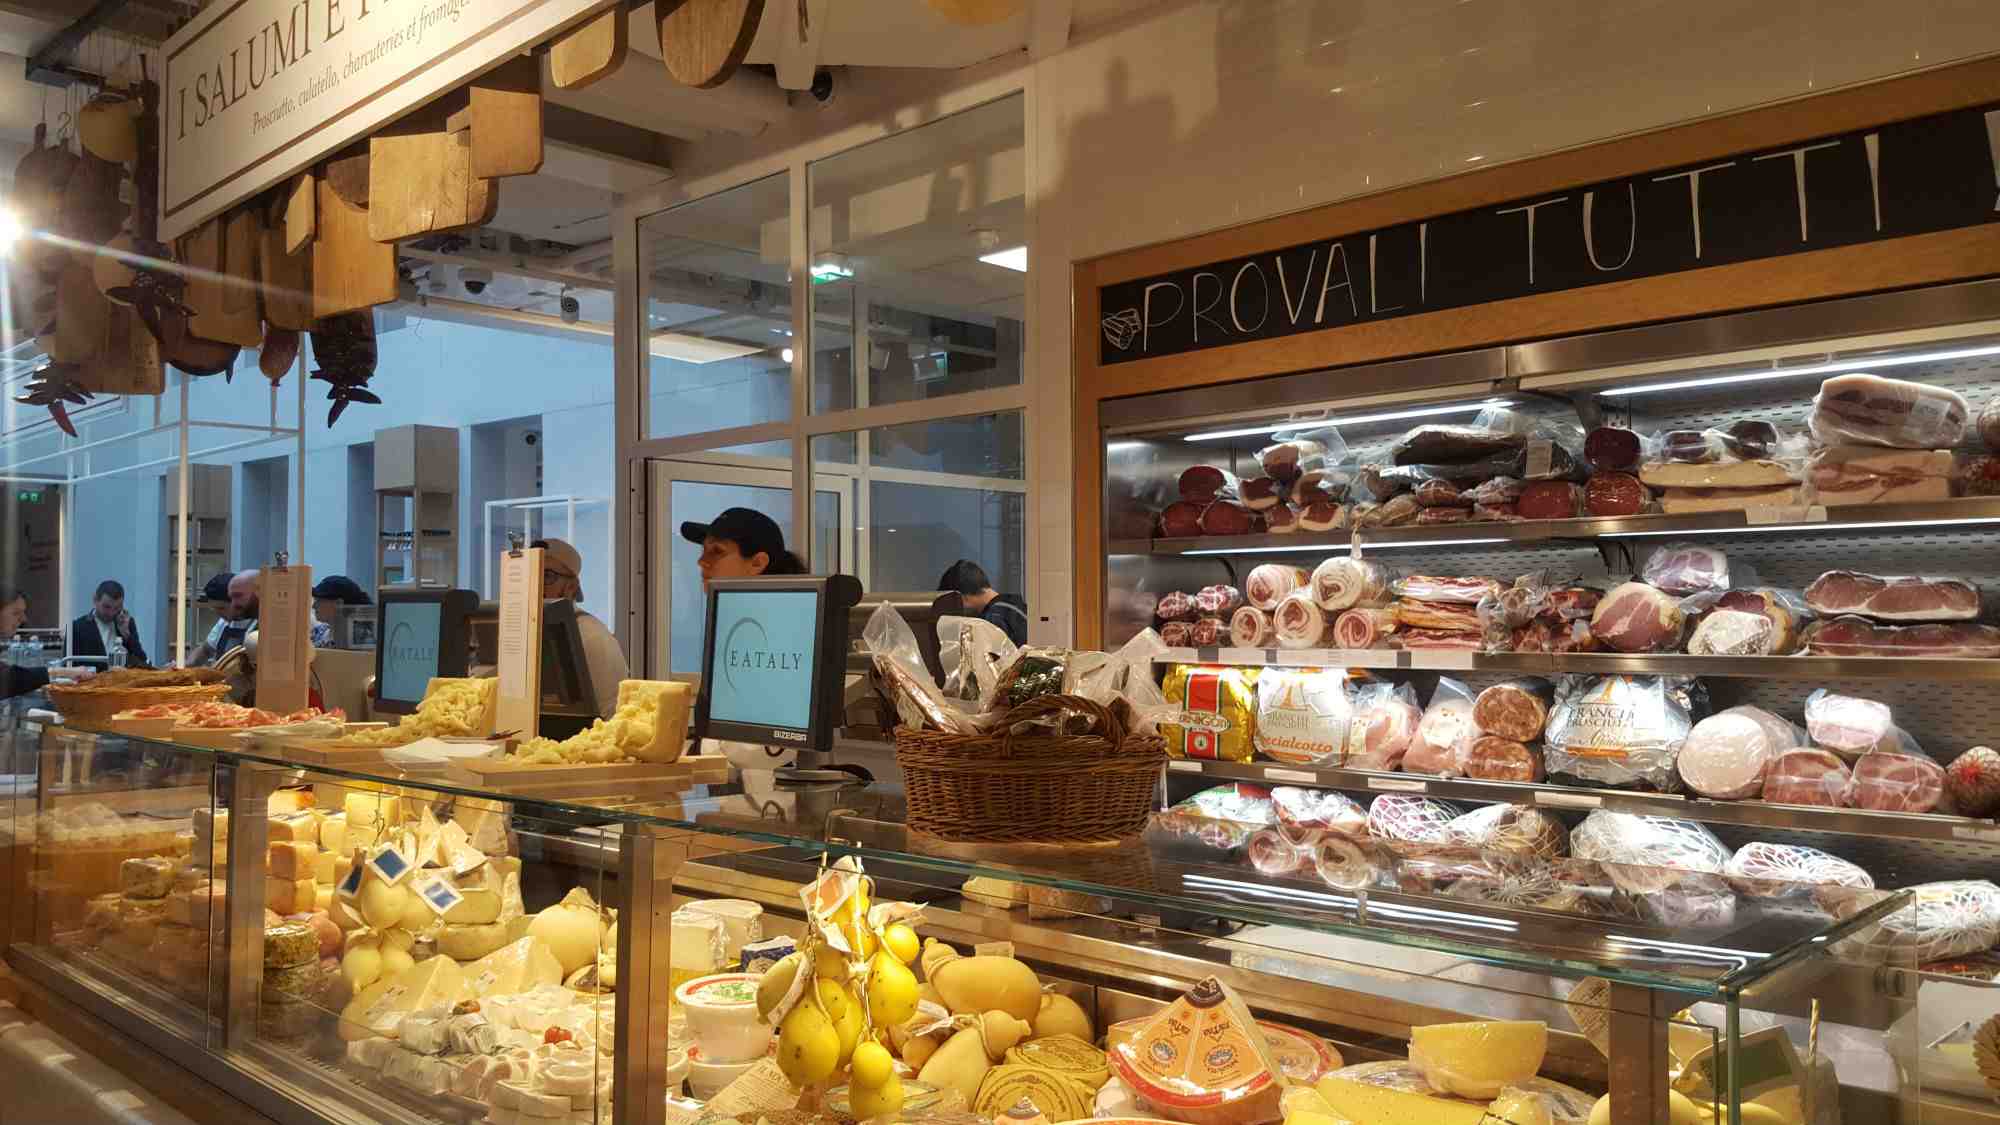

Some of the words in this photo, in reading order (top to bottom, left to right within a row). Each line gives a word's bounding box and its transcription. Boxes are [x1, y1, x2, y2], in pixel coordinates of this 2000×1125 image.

[178, 87, 187, 140] I
[194, 0, 312, 128] SALUMI
[299, 64, 340, 107] culatello,
[343, 27, 405, 79] charcuteries
[406, 14, 417, 41] et
[1143, 223, 1428, 353] PROVALI
[1496, 133, 1884, 285] TUTTI
[730, 649, 803, 671] EATALY
